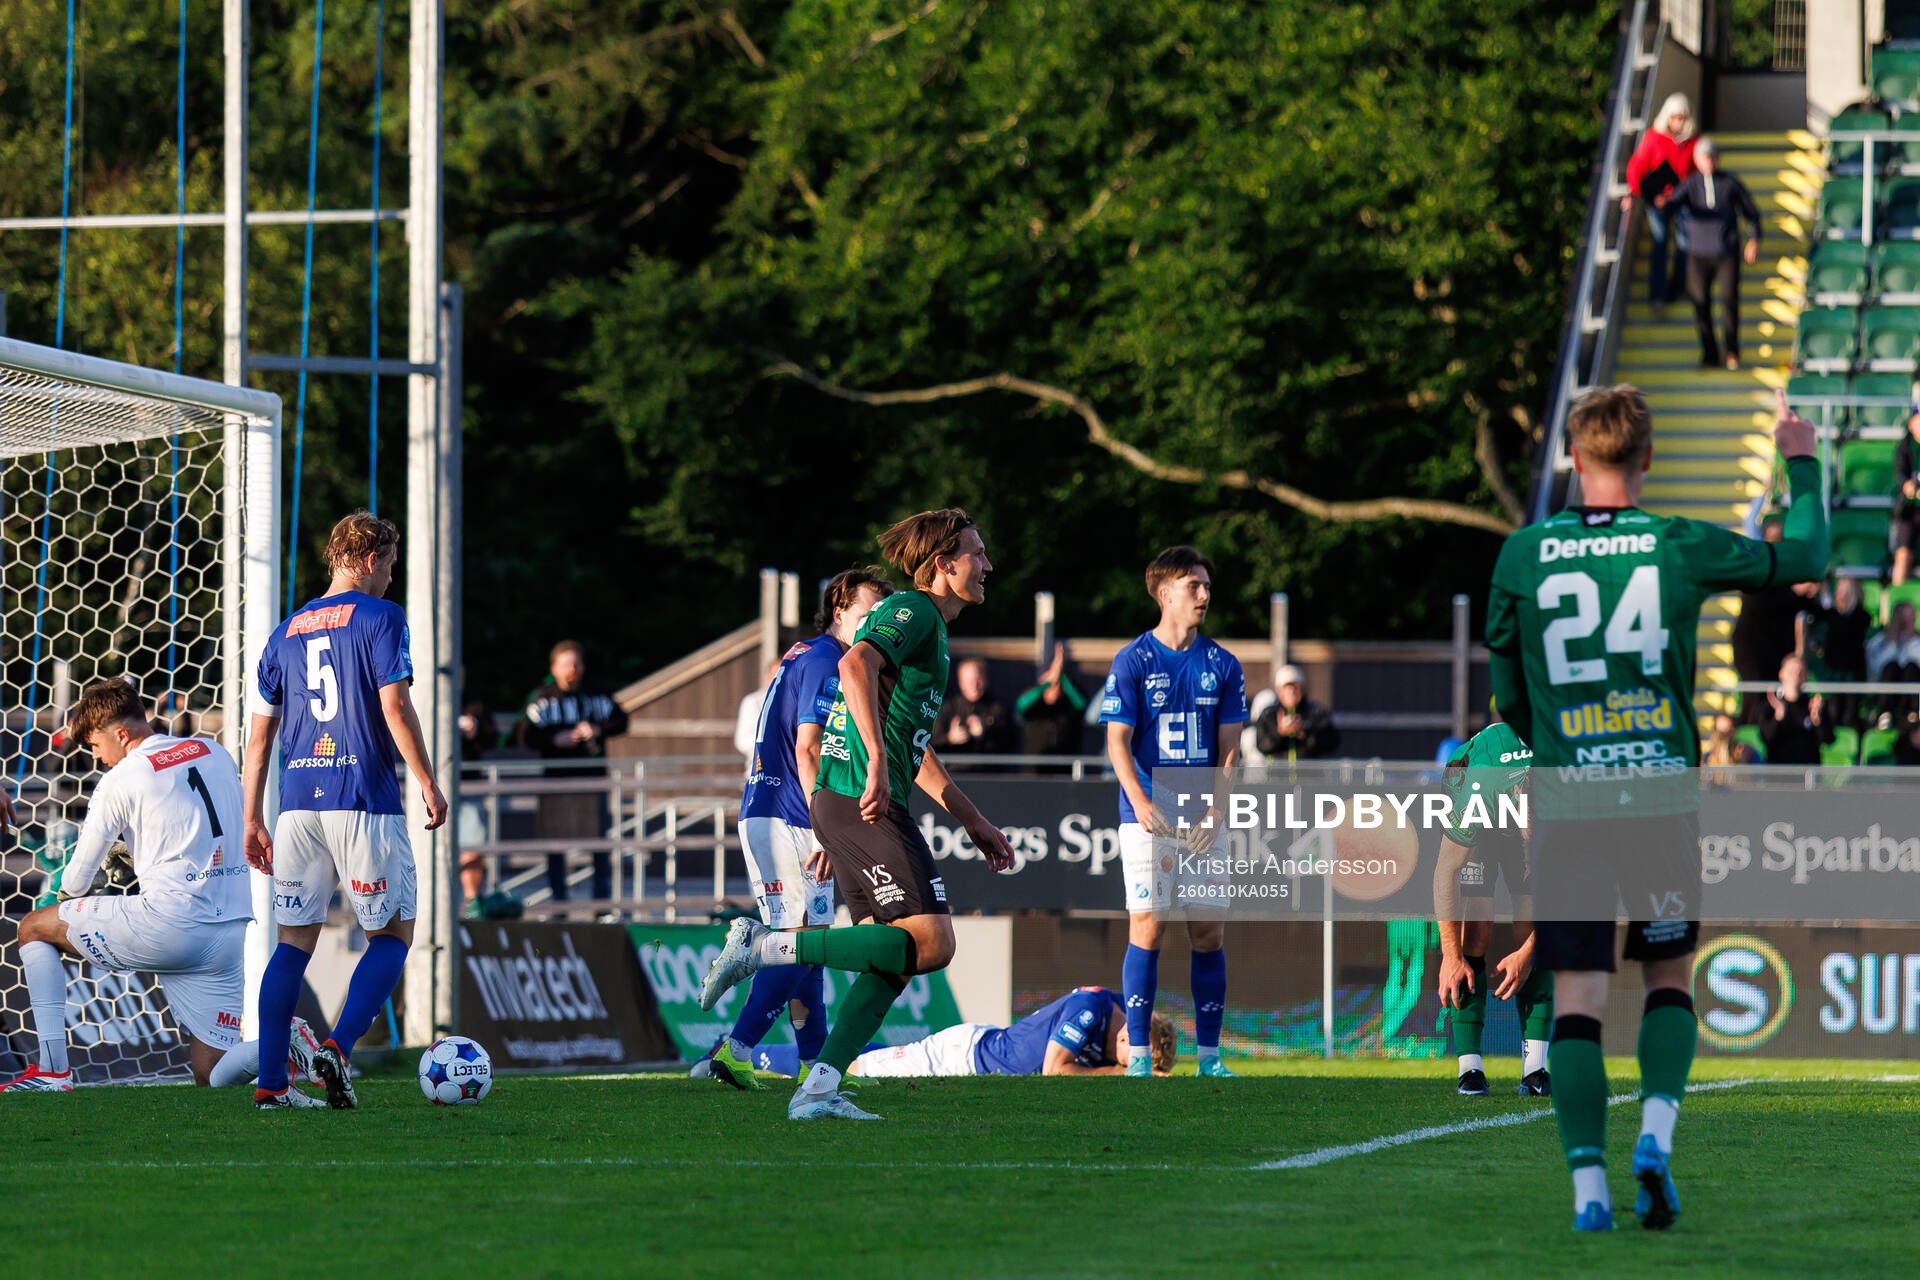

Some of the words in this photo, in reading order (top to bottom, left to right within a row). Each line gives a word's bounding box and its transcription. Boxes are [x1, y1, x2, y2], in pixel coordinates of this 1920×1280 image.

[1539, 533, 1657, 563] Derome
[1536, 565, 1670, 686] 24
[306, 635, 339, 723] 5
[1559, 697, 1673, 738] Ullared
[1158, 711, 1209, 760] EL
[155, 743, 201, 766] elcenter
[1577, 739, 1667, 763] NORDIC
[1557, 756, 1687, 784] WELLNESS
[187, 766, 224, 839] 1
[351, 880, 387, 894] MAXI
[862, 864, 892, 887] VS
[1649, 890, 1686, 918] VS
[453, 1064, 488, 1077] SELECT
